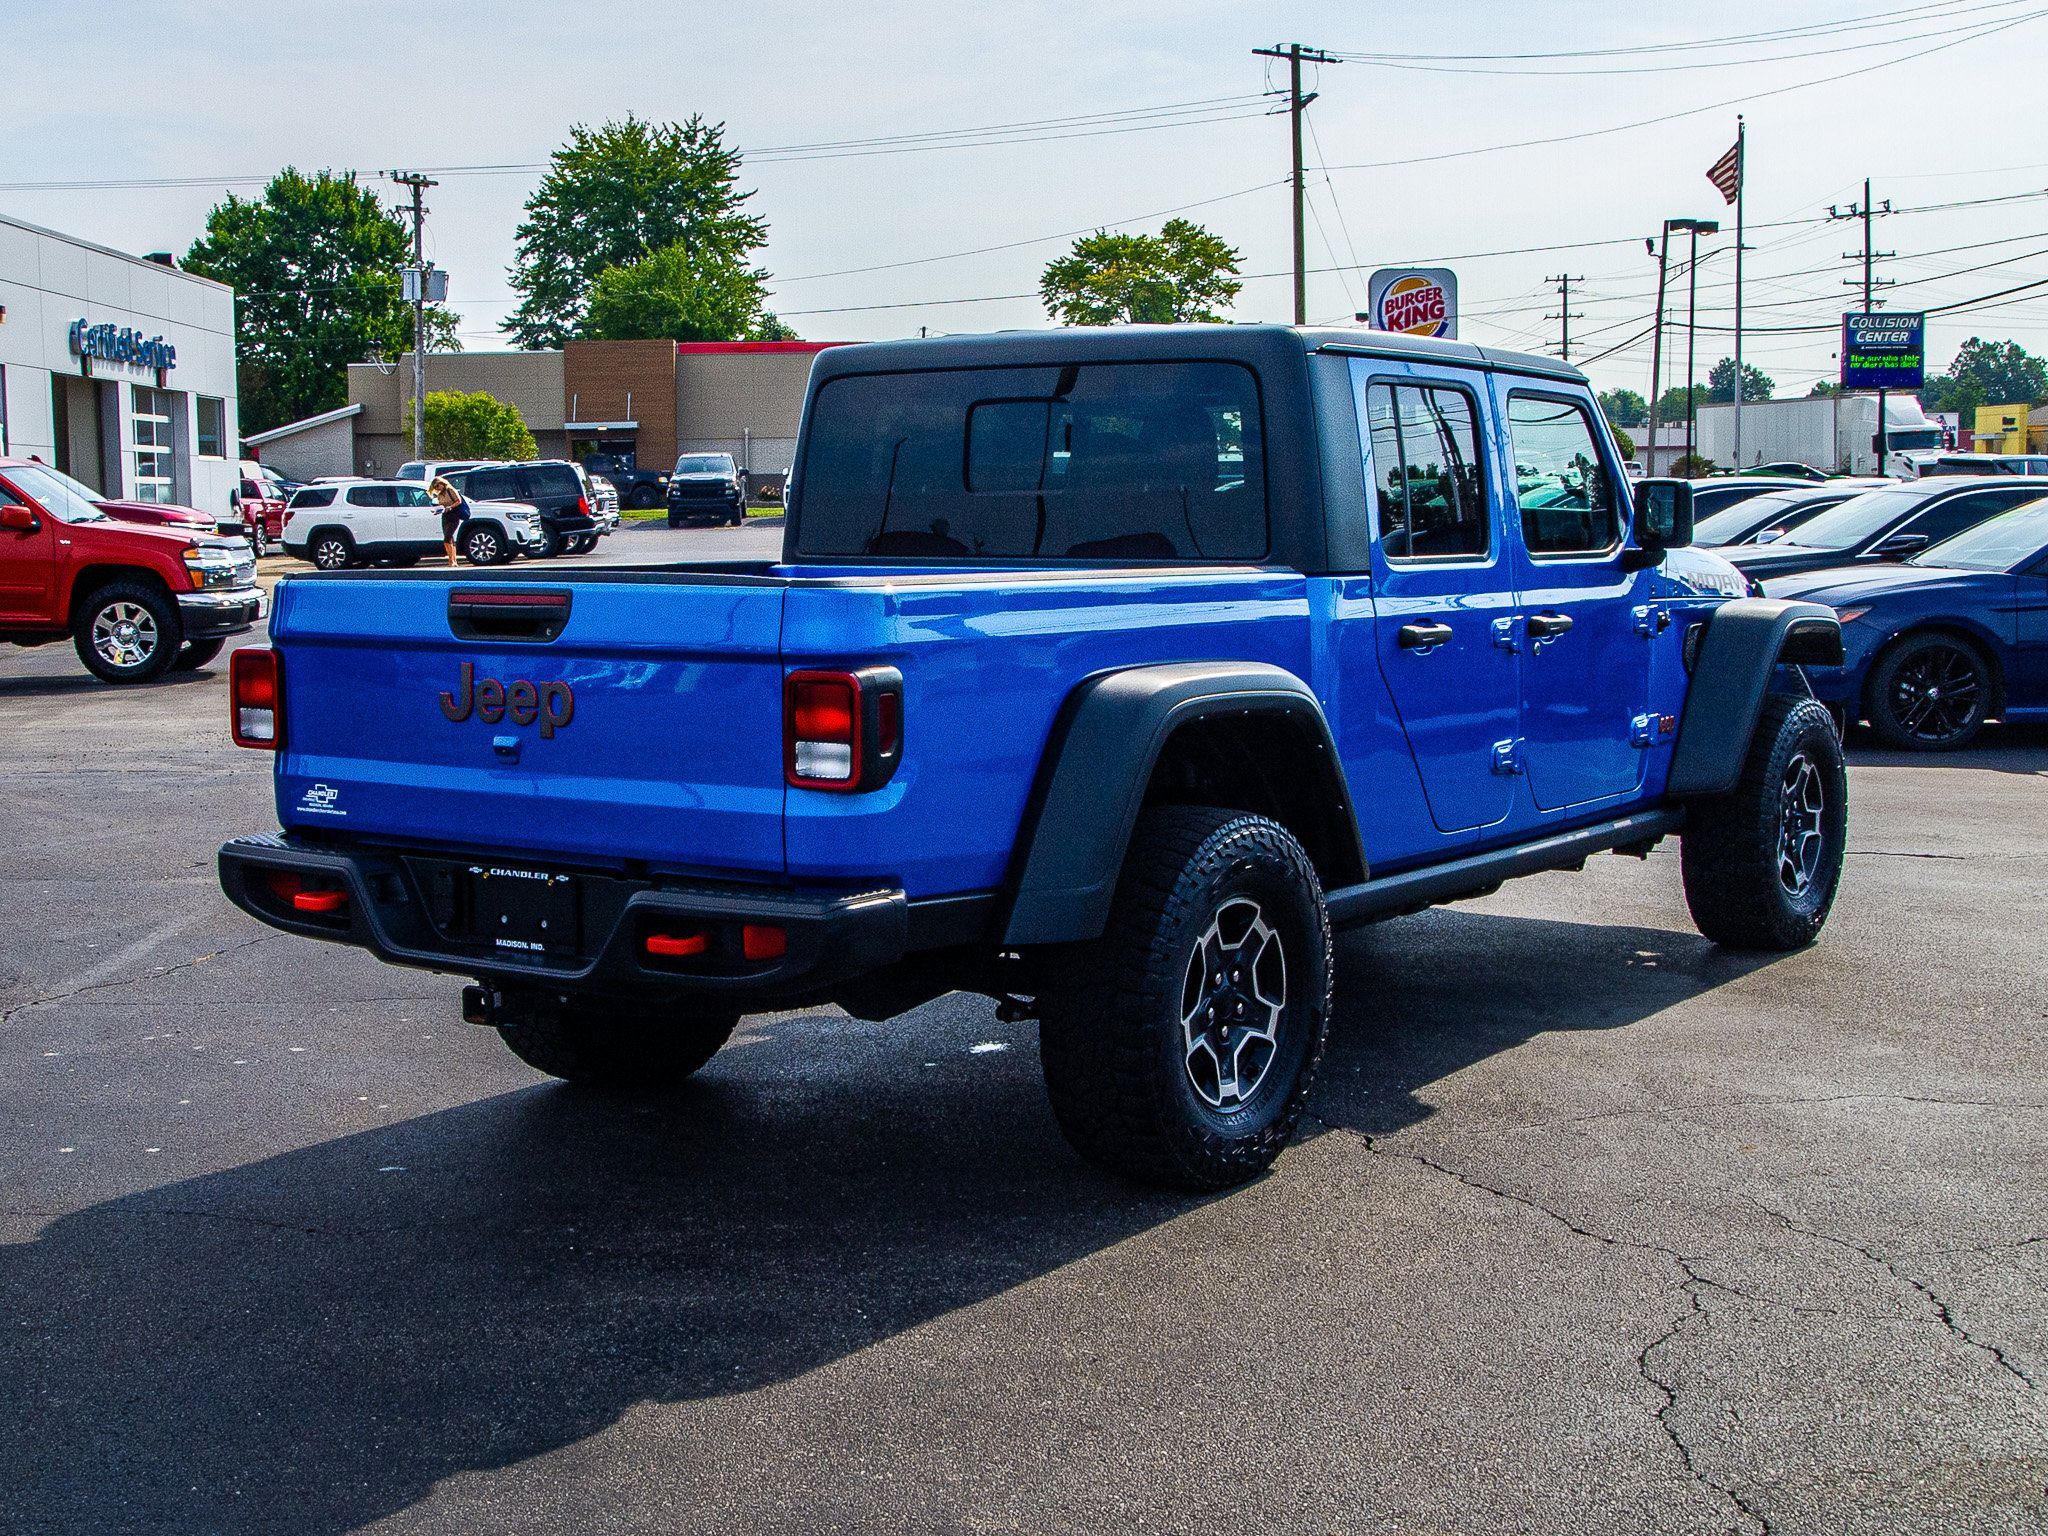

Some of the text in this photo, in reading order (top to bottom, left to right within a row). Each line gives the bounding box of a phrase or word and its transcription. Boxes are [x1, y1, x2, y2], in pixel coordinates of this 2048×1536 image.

[1384, 286, 1443, 315] BURGER
[1387, 299, 1445, 332] KING
[1849, 316, 1919, 329] COLLISION
[68, 317, 177, 370] Certified Service
[1856, 331, 1909, 343] CENTER
[1850, 354, 1865, 362] The
[439, 661, 575, 739] Jeep
[490, 868, 549, 880] CHANDLER
[530, 942, 546, 952] IND.
